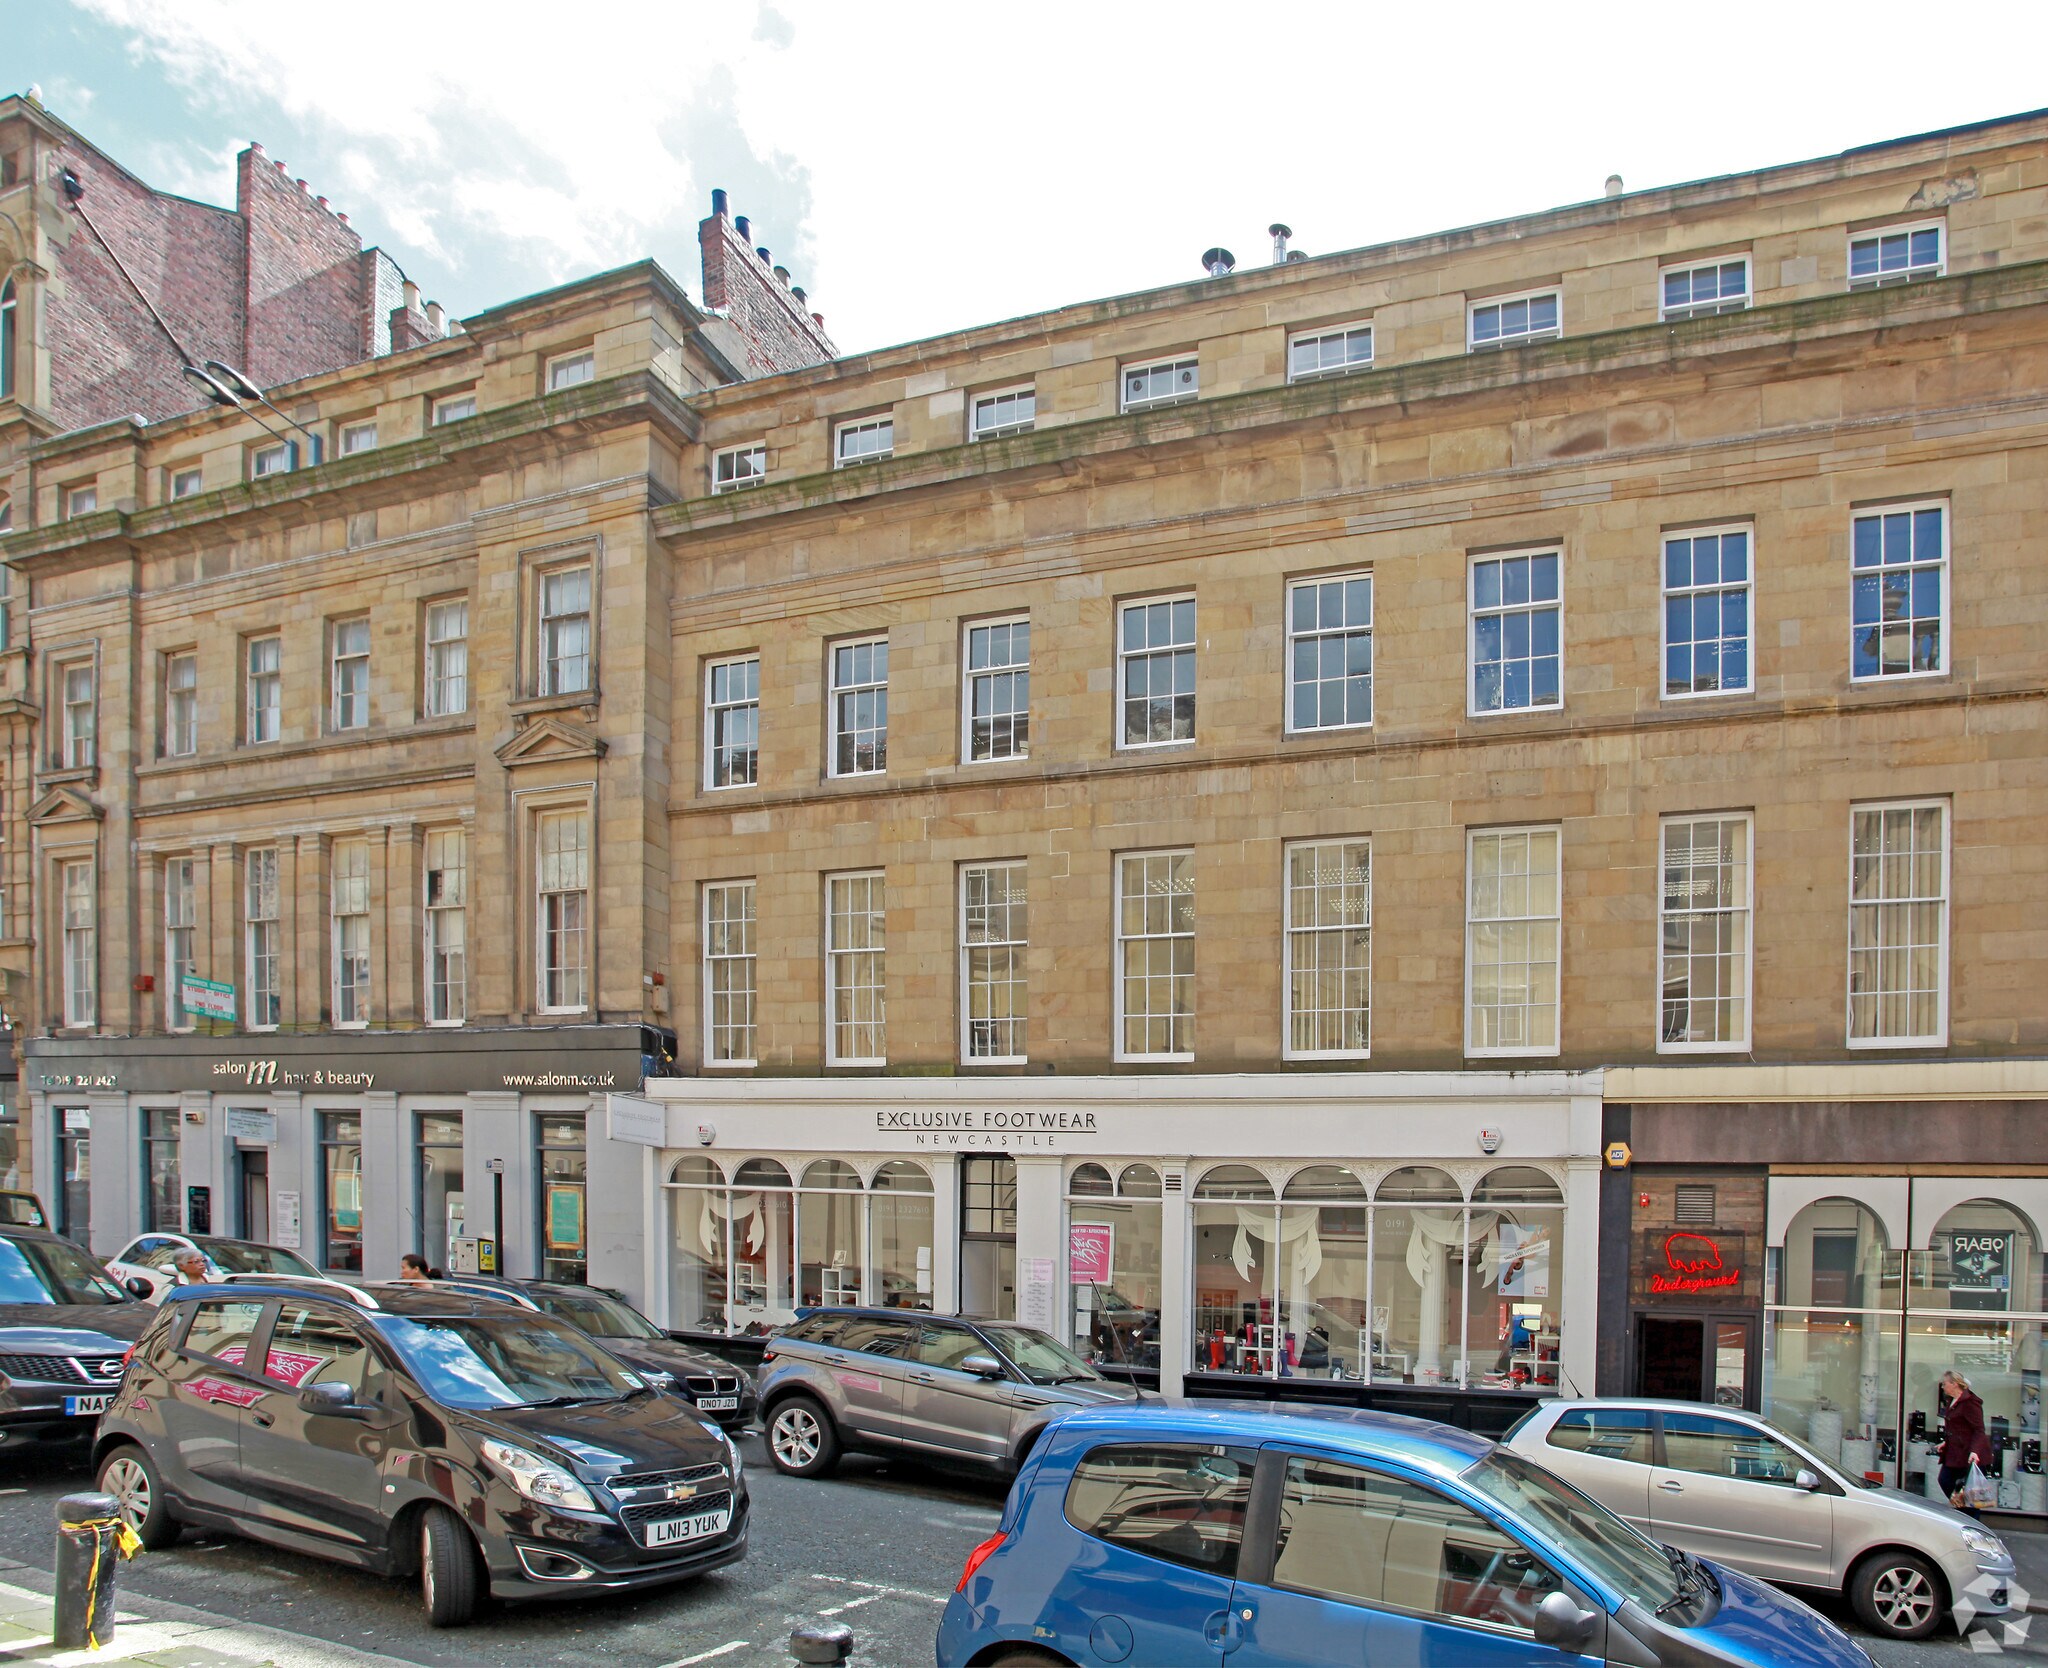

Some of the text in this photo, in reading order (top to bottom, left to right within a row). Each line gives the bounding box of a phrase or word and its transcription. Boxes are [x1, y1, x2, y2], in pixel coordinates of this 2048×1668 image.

[213, 991, 231, 999] OFFICE
[213, 1061, 246, 1074] salon
[285, 1071, 310, 1084] hair
[314, 1071, 324, 1084] &
[328, 1071, 374, 1087] beauty
[502, 1071, 616, 1086] www.salonm.co.uk
[876, 1112, 1097, 1128] EXCLUSIVE FOOTWEAR
[916, 1135, 1055, 1146] NEWCASTLE
[1385, 1219, 1405, 1228] 0191
[484, 1244, 492, 1255] P
[1651, 1269, 1739, 1293] Underground
[701, 1399, 721, 1409] DN07
[657, 1514, 720, 1541] LN13 YUK
